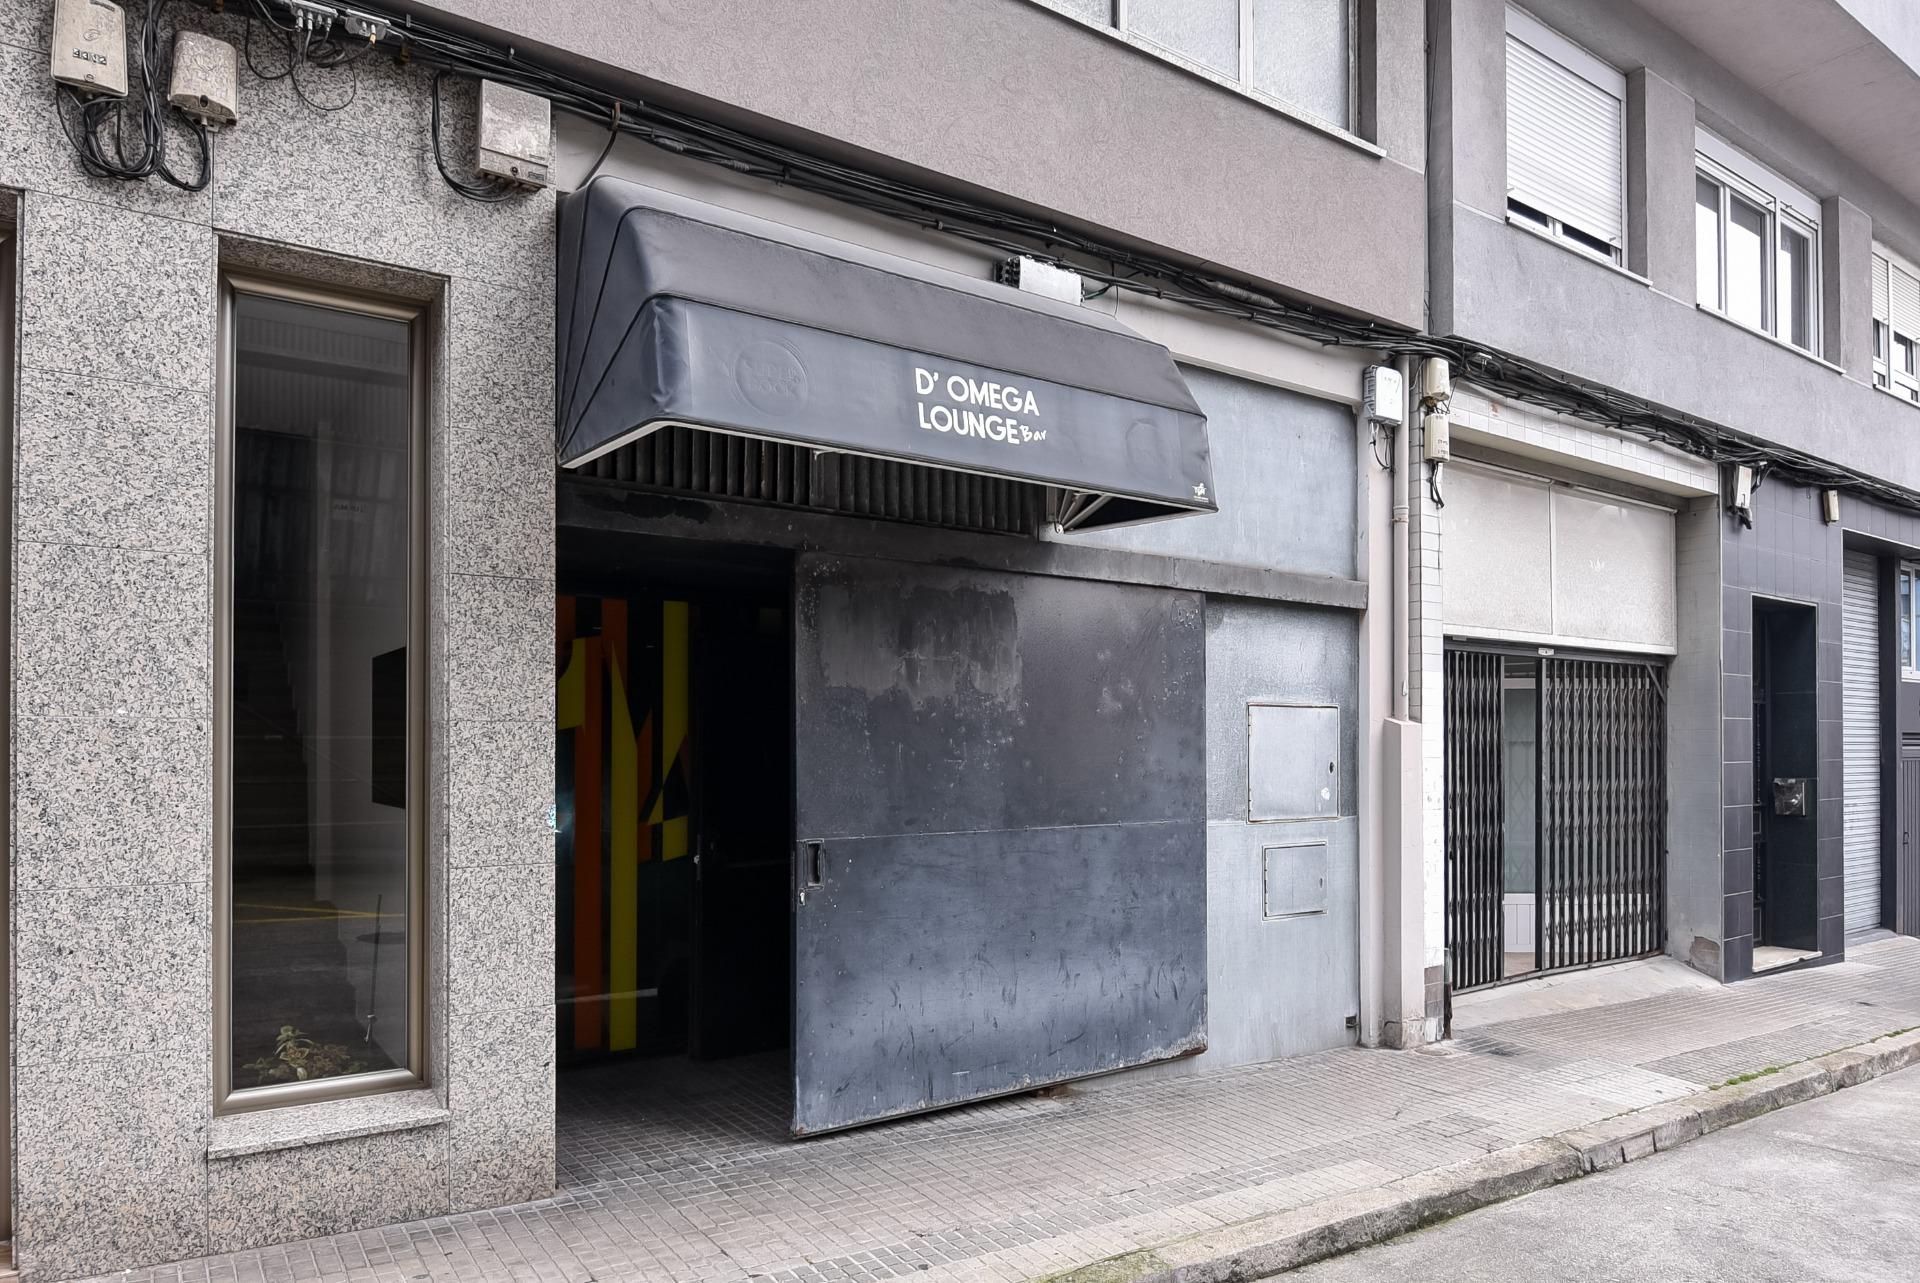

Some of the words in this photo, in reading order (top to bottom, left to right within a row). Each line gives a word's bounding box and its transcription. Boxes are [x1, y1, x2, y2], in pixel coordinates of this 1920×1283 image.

[915, 367, 939, 395] D'
[946, 375, 1040, 417] OMEGA
[918, 402, 1020, 445] LOUNGE
[1019, 424, 1047, 443] Bar
